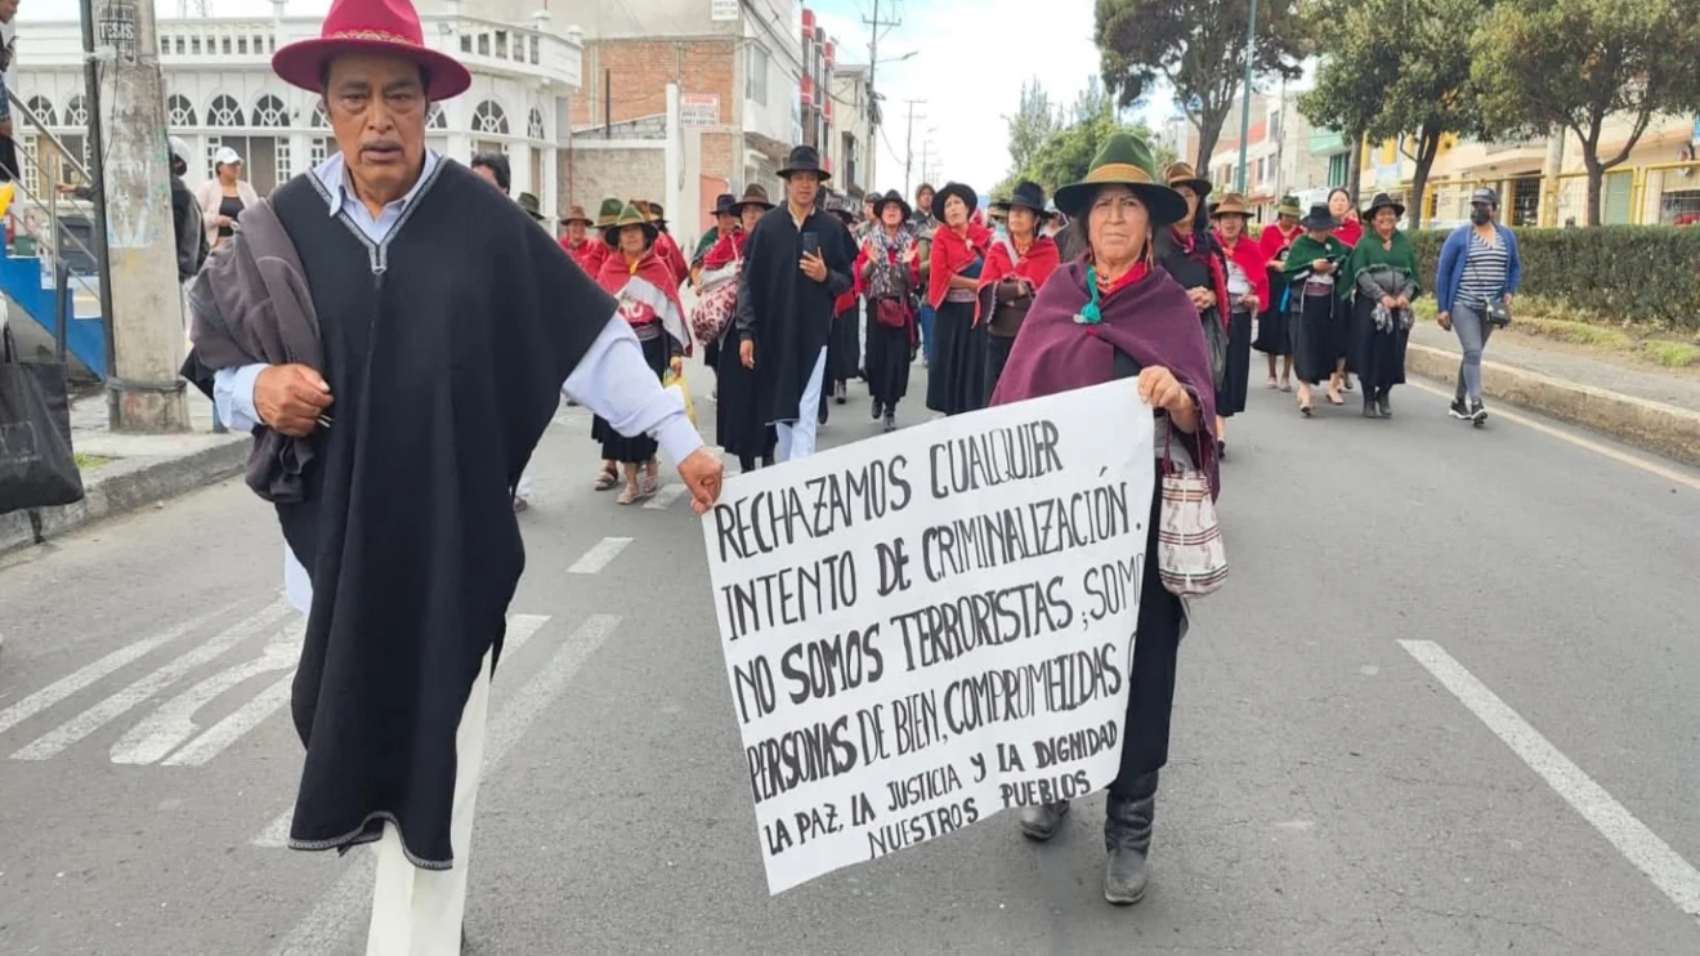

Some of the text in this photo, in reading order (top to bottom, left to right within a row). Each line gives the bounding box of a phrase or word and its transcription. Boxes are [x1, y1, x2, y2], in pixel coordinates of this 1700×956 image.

[714, 420, 1064, 562] RECHAZAMOS CUALQUIER
[721, 466, 1142, 641] INTENTO DE CRIMINALIZACIÓN.
[733, 654, 776, 724] NO
[781, 622, 884, 705] SOMOS
[747, 714, 858, 804] PERSONAS
[856, 703, 890, 766] DE
[892, 688, 949, 756] BIEN,
[943, 643, 1122, 735] COMPROMETIDAS
[763, 817, 794, 856] LA
[794, 802, 844, 845] PAZ,
[851, 791, 877, 826] LA
[886, 763, 963, 813] JUSTICIA
[996, 742, 1025, 773] LA
[1032, 719, 1118, 769] DIGNIDAD
[867, 769, 1091, 860] NUESTROS PUEBLOS
